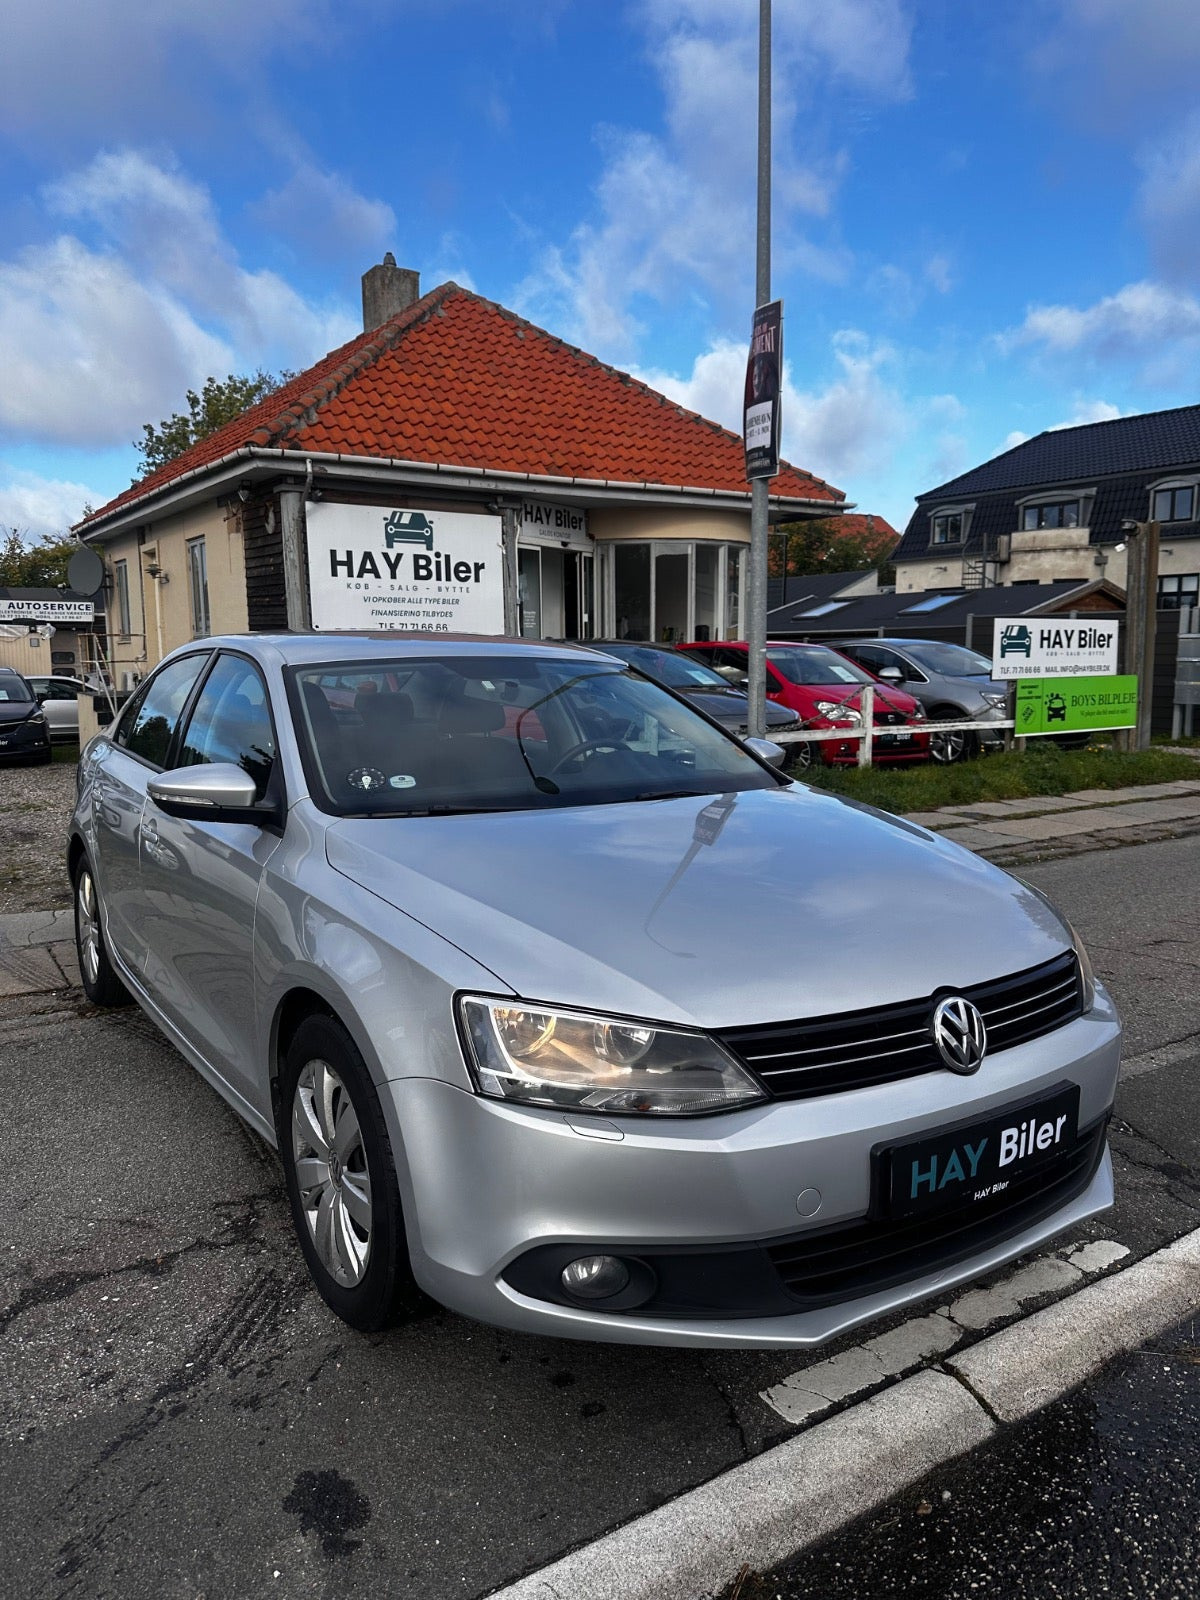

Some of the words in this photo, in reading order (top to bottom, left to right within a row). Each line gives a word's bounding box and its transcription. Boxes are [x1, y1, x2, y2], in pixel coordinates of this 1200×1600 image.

[524, 504, 552, 525] HAY
[556, 509, 584, 530] Biler
[330, 549, 404, 580] HAY
[414, 552, 485, 583] Biler
[8, 602, 91, 611] AUTOSERVICE
[1040, 630, 1074, 649] HAY
[1078, 628, 1113, 648] Biler
[1071, 695, 1097, 707] BOYS
[1098, 692, 1136, 705] BILPLEJE
[910, 1137, 989, 1199] HAY
[998, 1114, 1067, 1168] Biler
[973, 1187, 991, 1200] HAY
[992, 1181, 1010, 1194] Biler
